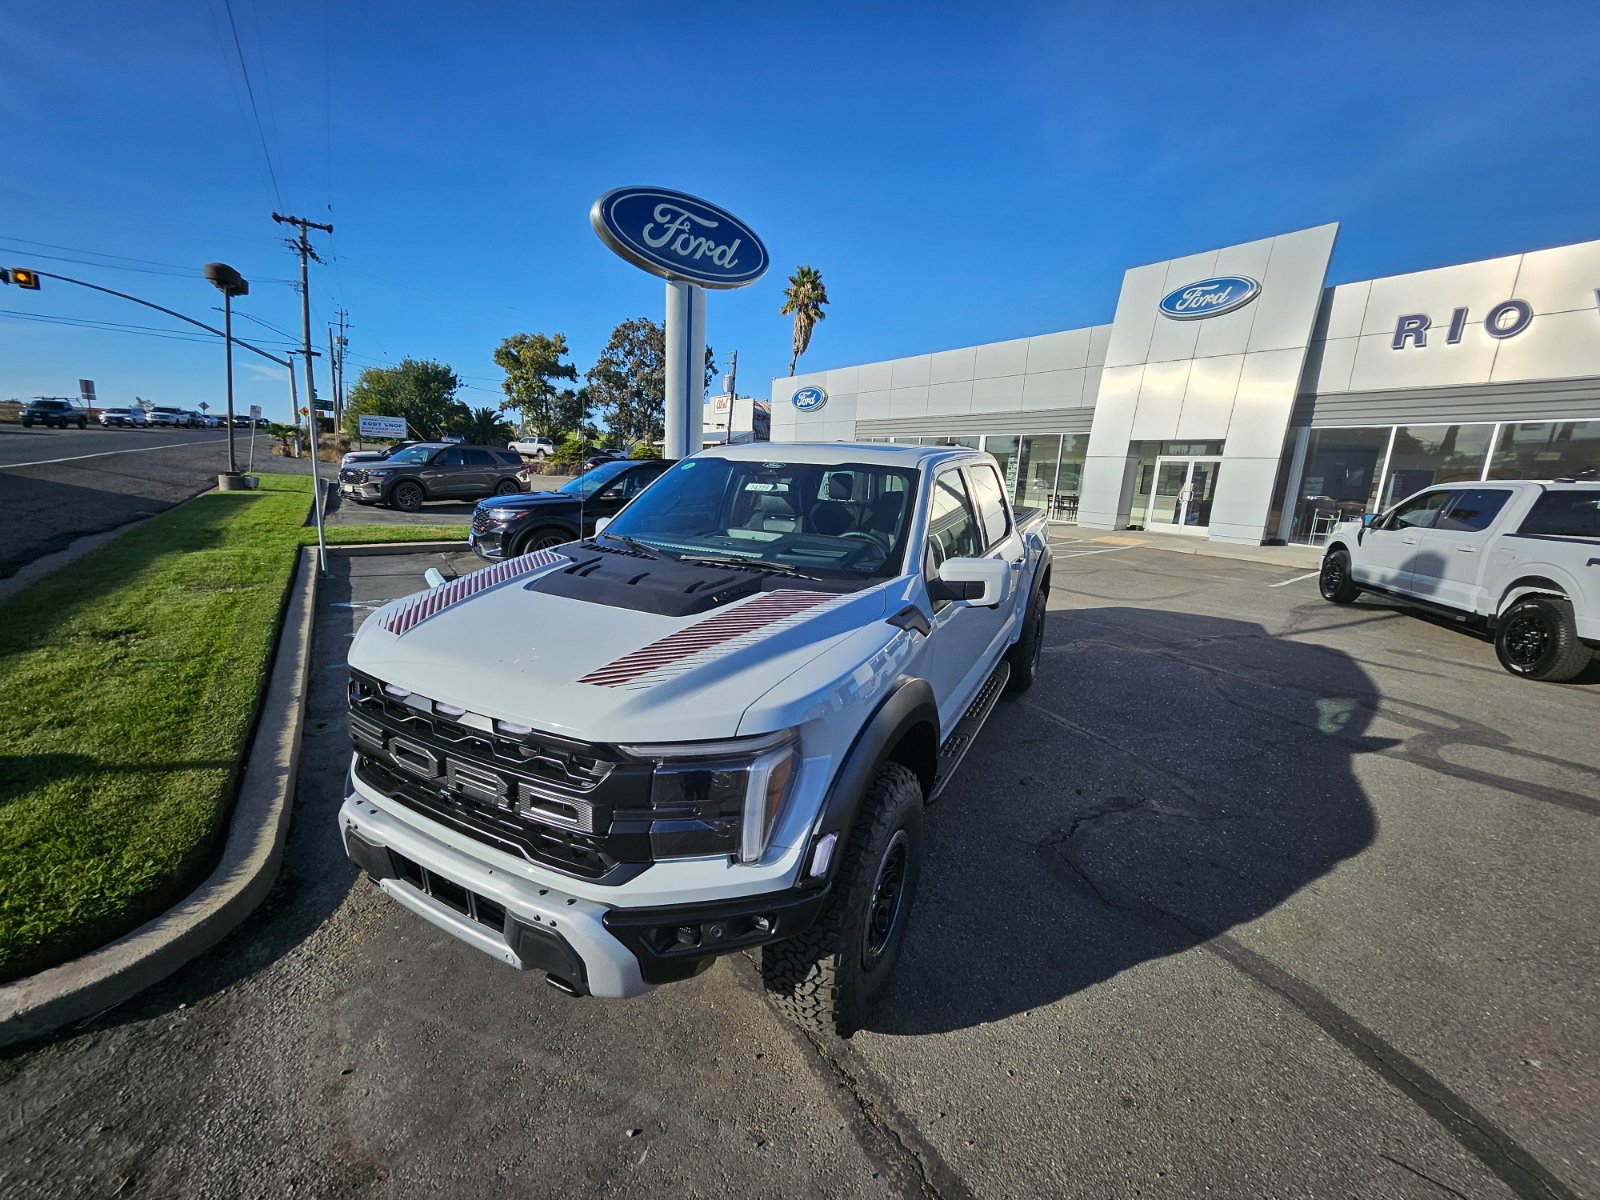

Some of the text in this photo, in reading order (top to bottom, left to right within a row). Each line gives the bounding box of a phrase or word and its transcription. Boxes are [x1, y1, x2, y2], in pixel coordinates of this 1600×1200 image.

[643, 203, 741, 269] Ford
[1176, 284, 1233, 311] Ford
[1391, 298, 1534, 350] RIO
[797, 391, 817, 406] Ford
[348, 711, 594, 835] FORD
